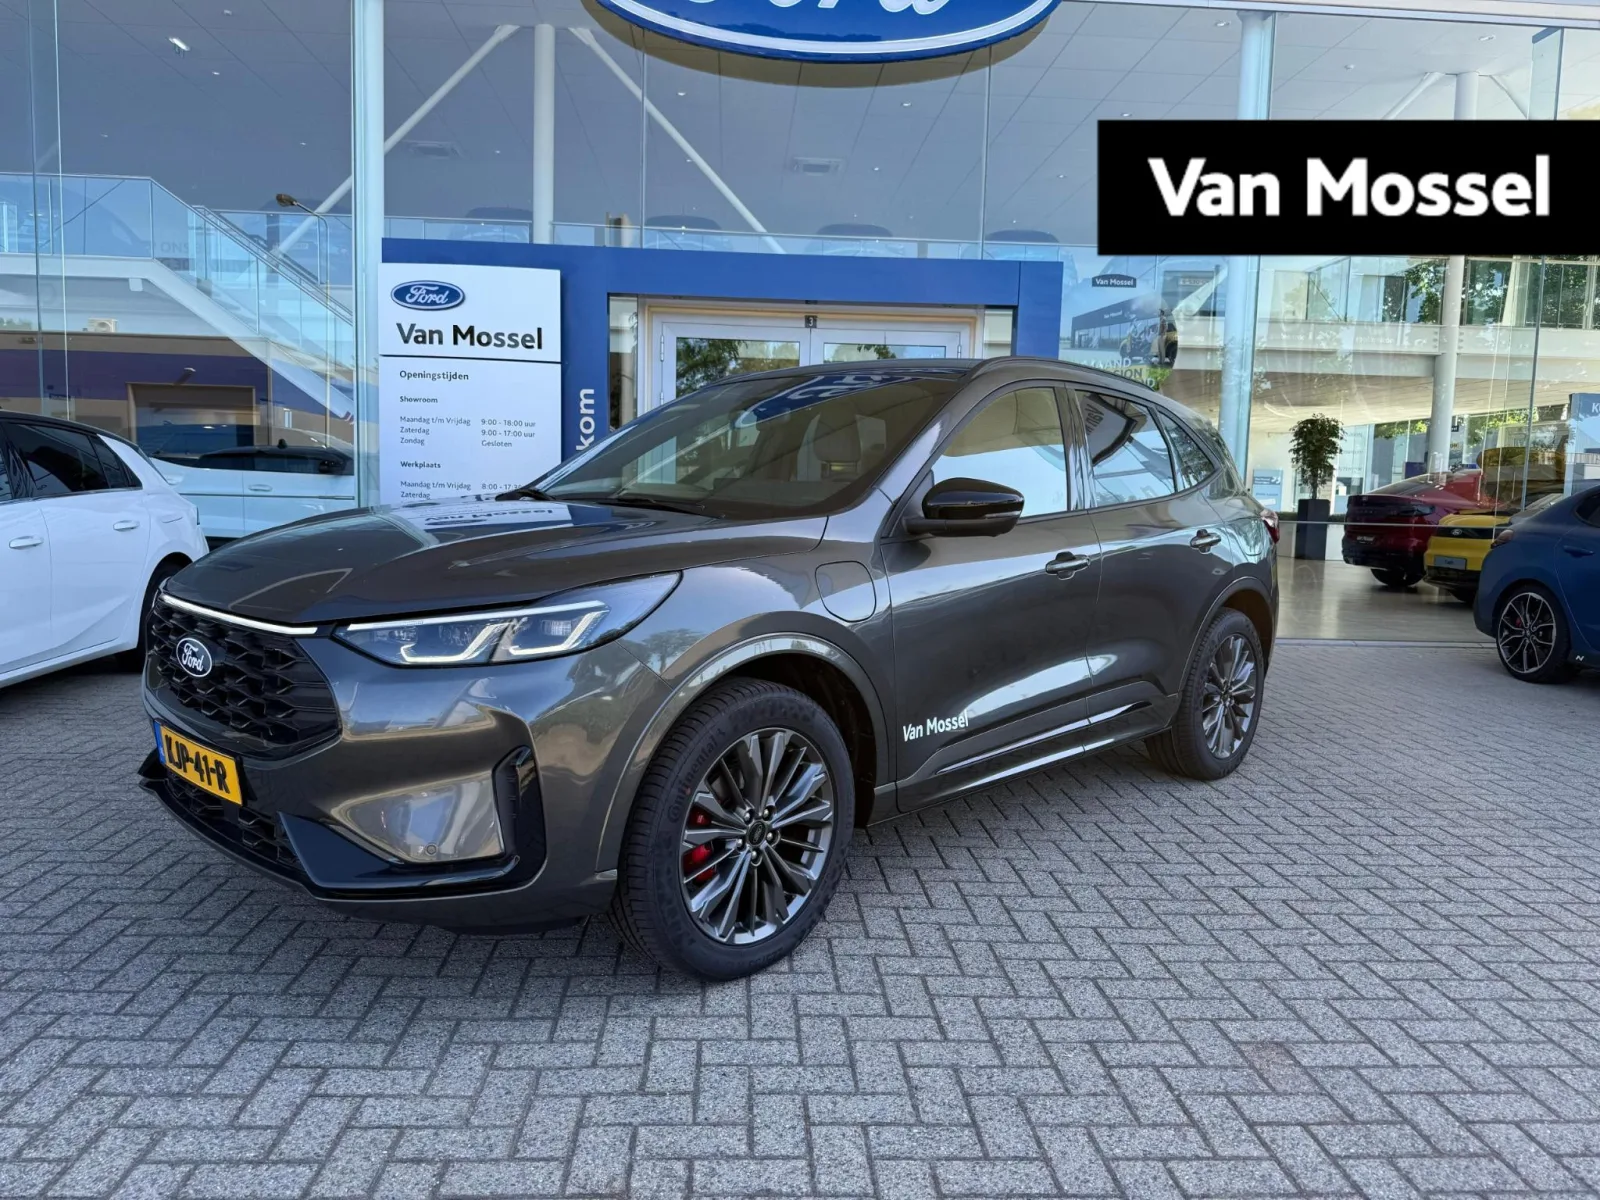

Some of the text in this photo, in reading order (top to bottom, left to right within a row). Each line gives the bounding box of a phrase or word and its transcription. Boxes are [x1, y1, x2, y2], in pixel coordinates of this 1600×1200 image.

[405, 285, 449, 304] Ford
[808, 316, 814, 326] 3
[396, 322, 543, 350] Van Mossel
[399, 370, 469, 382] Openingstijden
[399, 395, 438, 403] Showroom
[399, 416, 430, 424] Maandag
[446, 417, 471, 426] Vrijdag
[400, 426, 430, 435] Zaterdag
[400, 437, 425, 446] Zondag
[400, 461, 441, 469] Werkplaats
[400, 481, 431, 489] Maandag
[446, 482, 471, 490] Vrijdag
[400, 491, 430, 500] Zaterdag
[181, 642, 205, 672] Ford
[902, 709, 969, 742] Van Mossel
